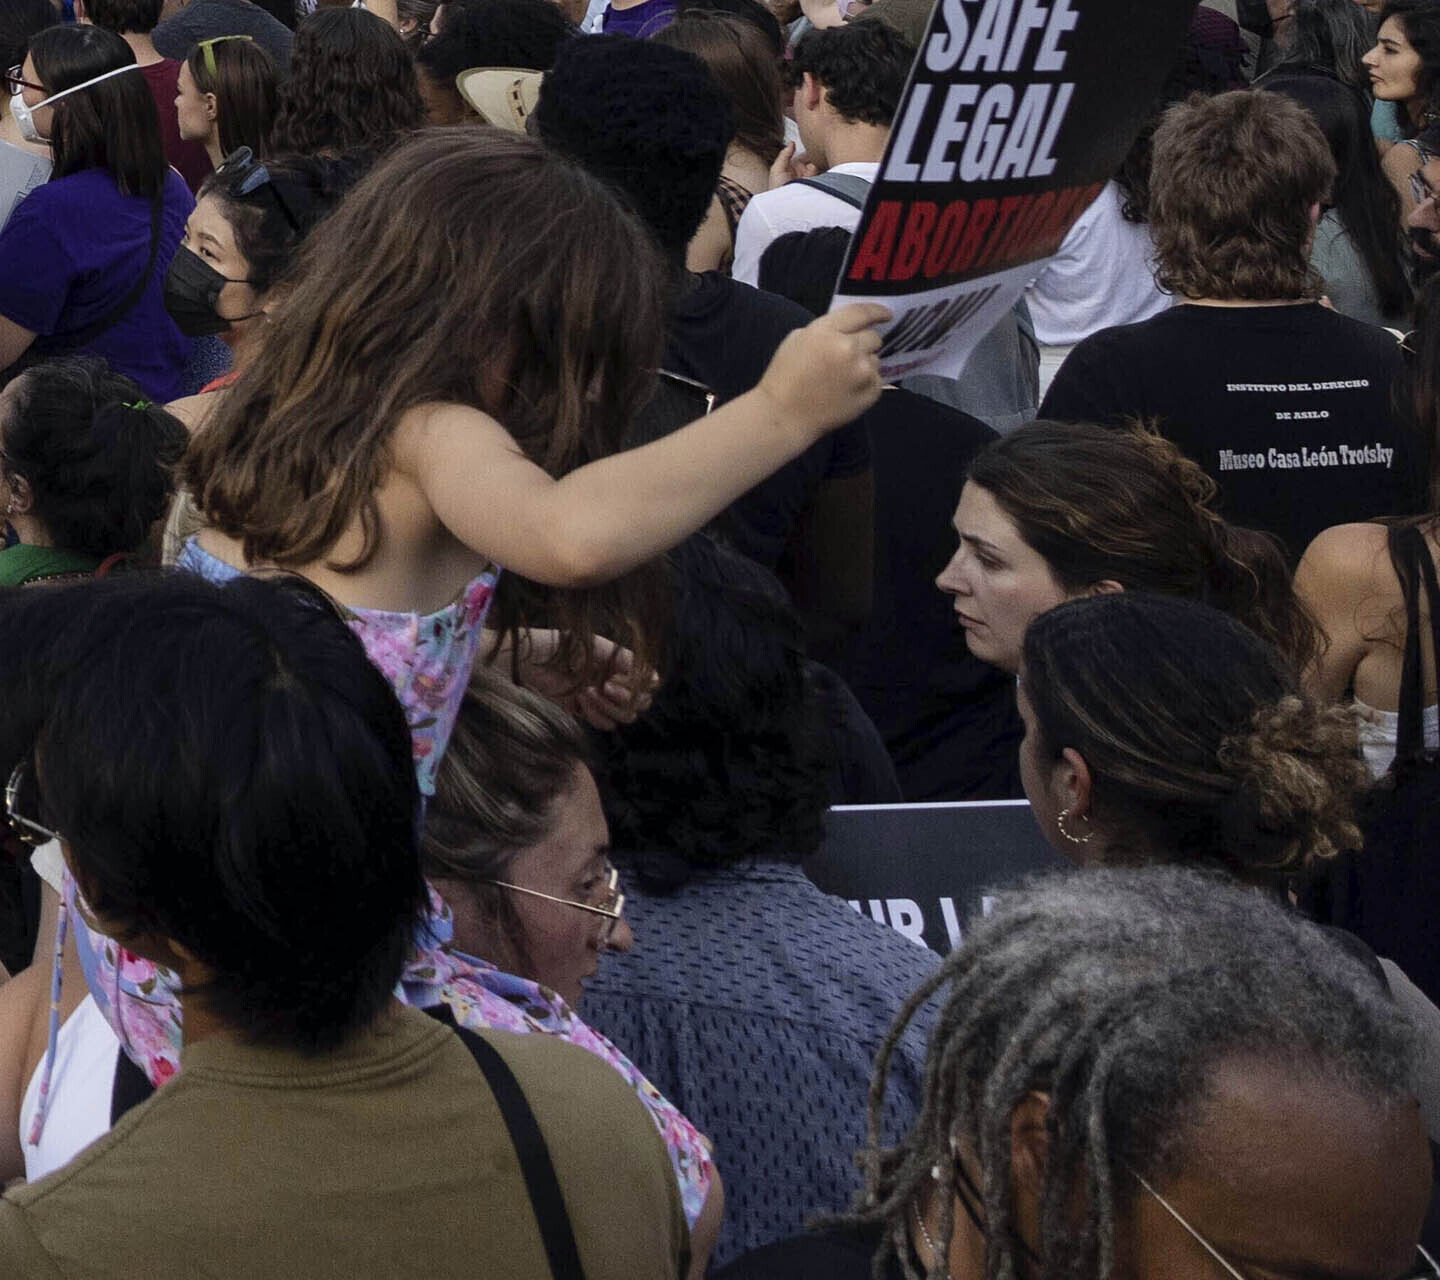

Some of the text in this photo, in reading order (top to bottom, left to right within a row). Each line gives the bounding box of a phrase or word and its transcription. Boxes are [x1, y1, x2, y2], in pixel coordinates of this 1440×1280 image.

[883, 83, 1076, 182] LEGAL
[1227, 379, 1369, 392] INSTITUTO DEL DERECHO
[1294, 411, 1329, 419] ASILO
[1219, 443, 1394, 470] Museo Casa León Trotsky
